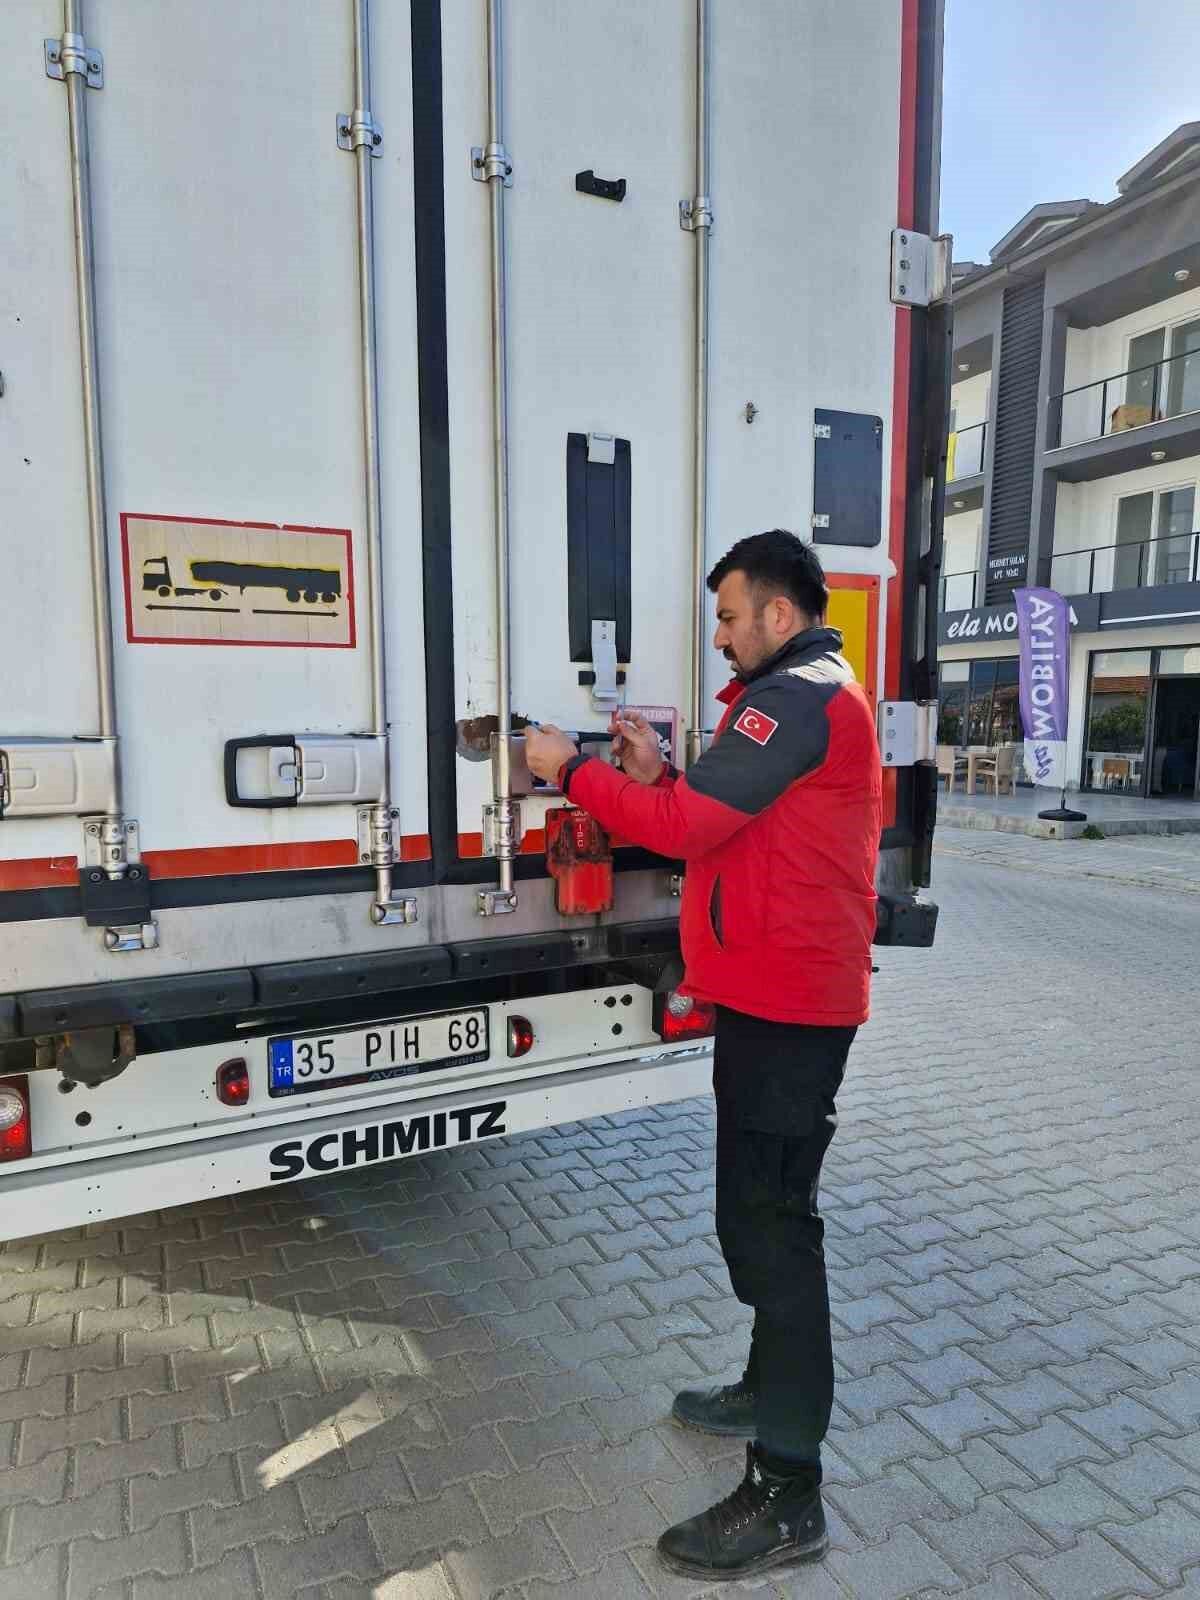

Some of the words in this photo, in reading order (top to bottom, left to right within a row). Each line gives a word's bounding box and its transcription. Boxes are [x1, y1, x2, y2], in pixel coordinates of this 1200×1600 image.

[947, 613, 981, 638] ela
[276, 1066, 291, 1077] TR
[297, 1039, 335, 1077] 35
[366, 1026, 420, 1067] PIH
[448, 1017, 480, 1052] 68
[269, 1101, 507, 1181] SCHMITZ
